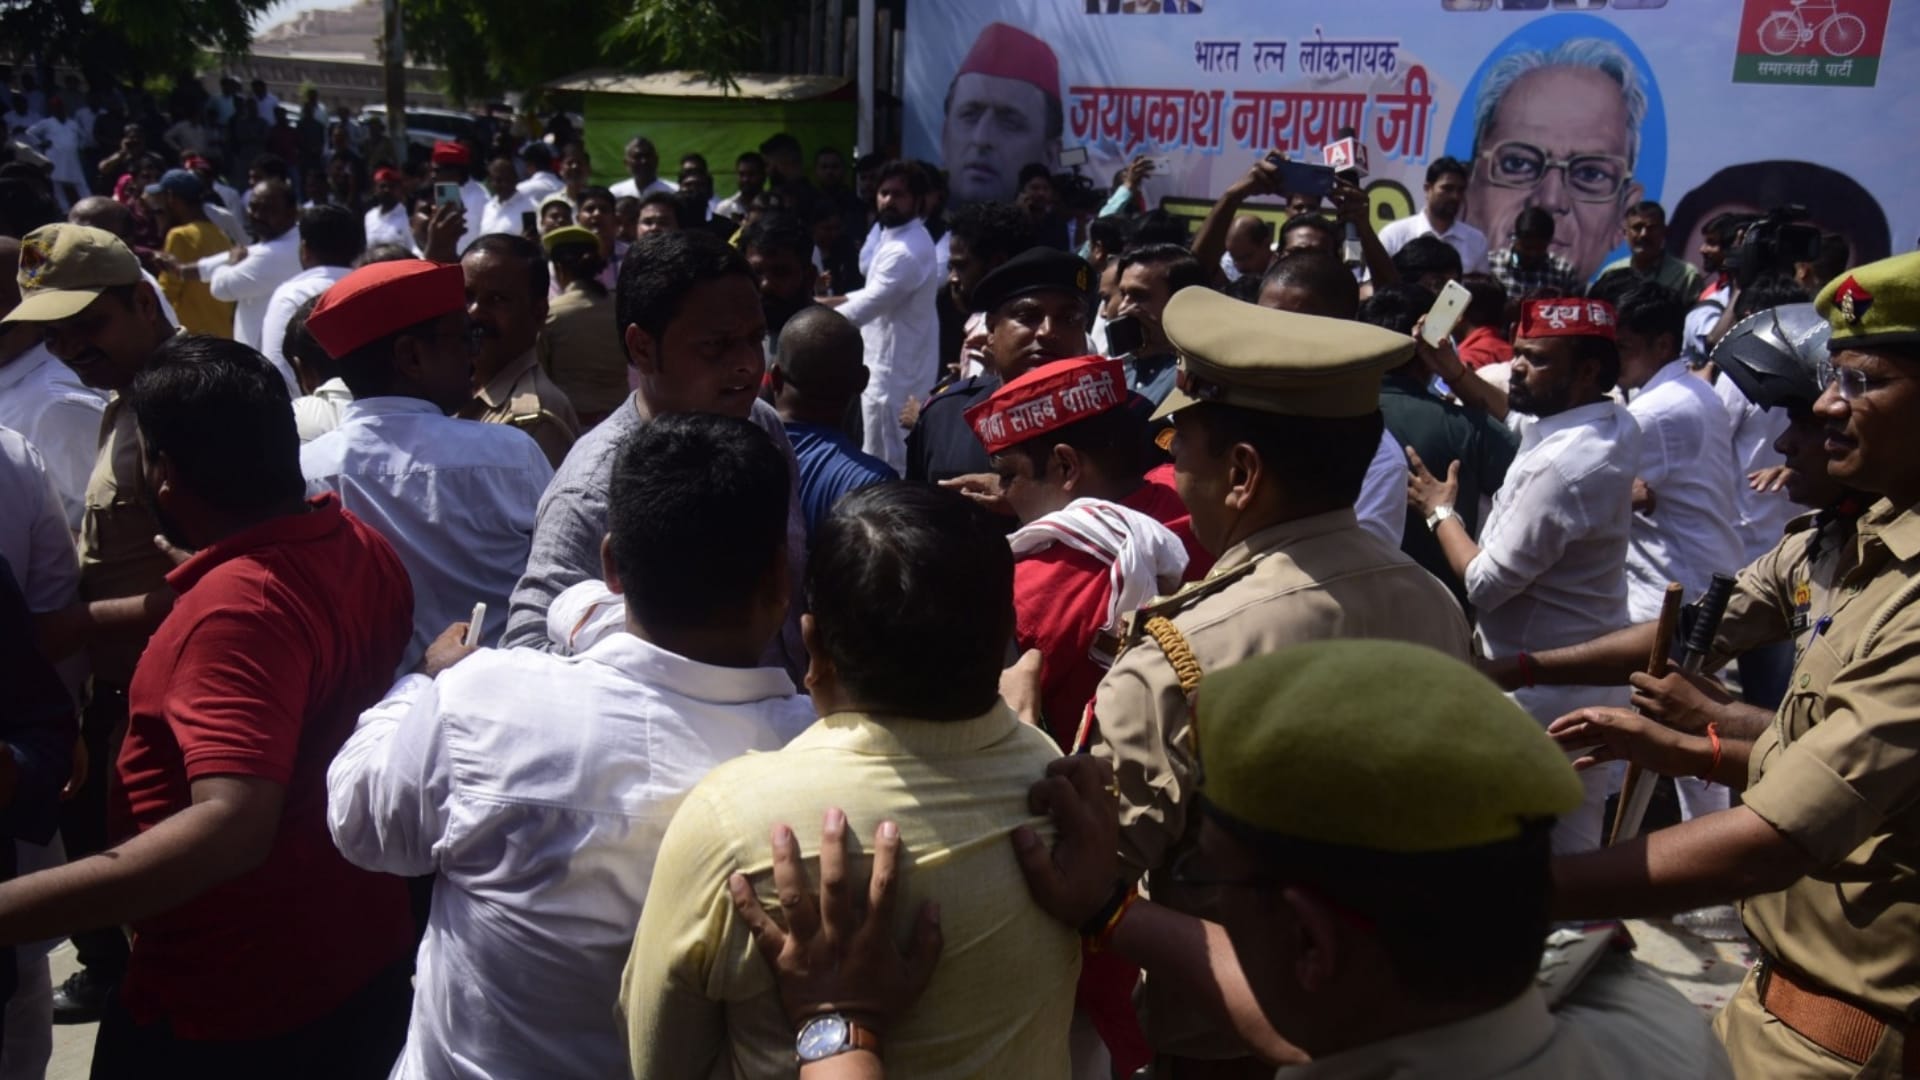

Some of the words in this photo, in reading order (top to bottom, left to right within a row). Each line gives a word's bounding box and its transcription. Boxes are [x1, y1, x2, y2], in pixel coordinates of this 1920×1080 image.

[1195, 40, 1240, 73] भारत
[1253, 42, 1287, 73] रत्न
[1300, 28, 1399, 74] लोकनायक
[1758, 59, 1819, 76] समाजवादी
[1825, 59, 1853, 77] पार्टी
[1070, 86, 1225, 154] जयप्रकाश
[1231, 91, 1367, 152] नारायण
[1376, 65, 1432, 156] जी
[1539, 305, 1580, 329] यूथ
[1008, 396, 1057, 432] साहब
[1058, 371, 1118, 413] वाहिनी
